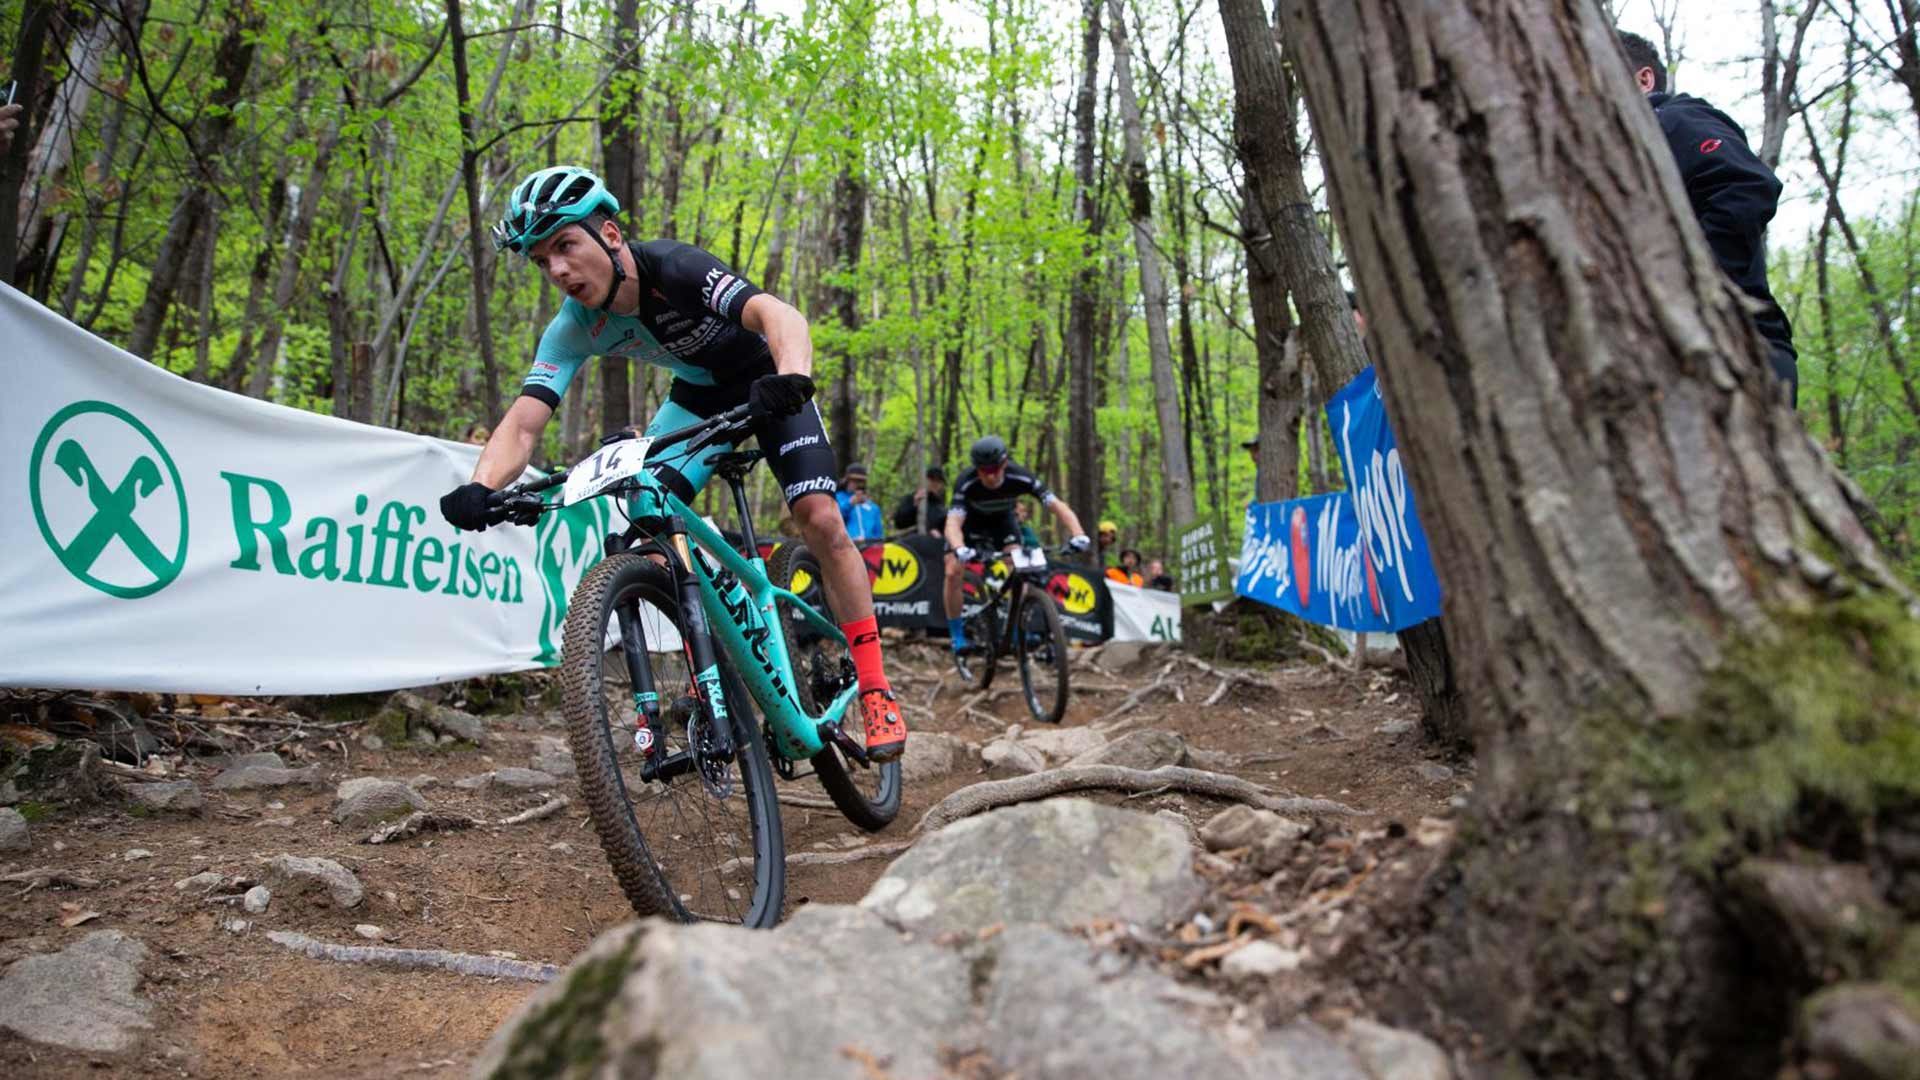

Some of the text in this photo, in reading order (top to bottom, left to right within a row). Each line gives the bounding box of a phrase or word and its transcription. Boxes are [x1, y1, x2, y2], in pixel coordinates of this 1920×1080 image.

[589, 446, 623, 482] 14
[785, 476, 837, 503] Santin
[220, 470, 523, 603] Raiffeisen
